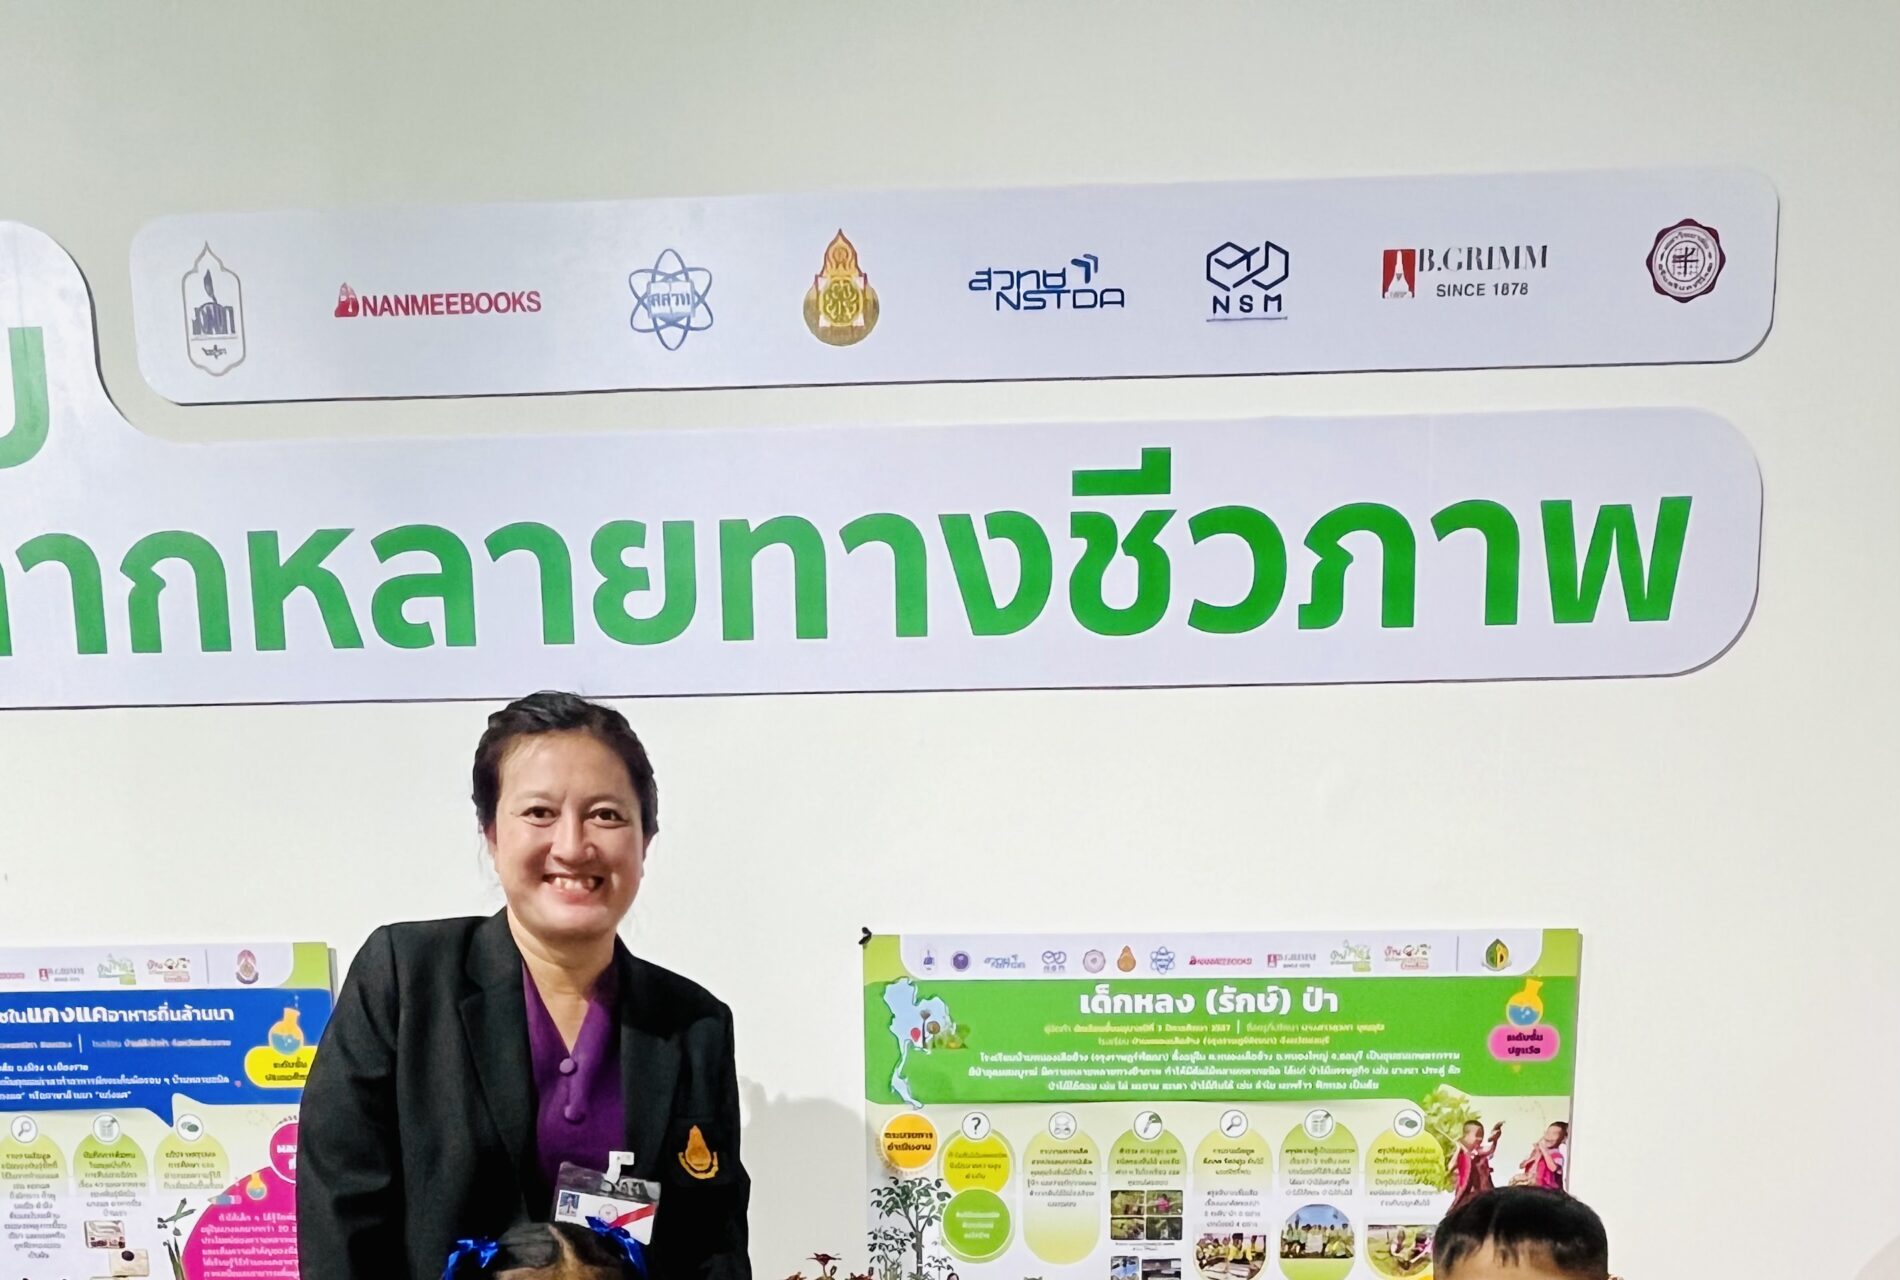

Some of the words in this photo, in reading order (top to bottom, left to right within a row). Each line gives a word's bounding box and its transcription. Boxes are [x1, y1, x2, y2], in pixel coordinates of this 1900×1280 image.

[1418, 245, 1548, 272] B.GRIMM
[996, 288, 1125, 311] NSTDA
[1436, 283, 1486, 297] SINCE
[1493, 282, 1529, 296] 1878
[362, 291, 541, 317] NANMEEBOOKS
[0, 447, 1693, 656] ากหลายทางชีวภาพ
[1079, 984, 1196, 1014] เด็กหลง
[1206, 986, 1291, 1015] (รักษ์)
[1302, 986, 1339, 1013] ป่า
